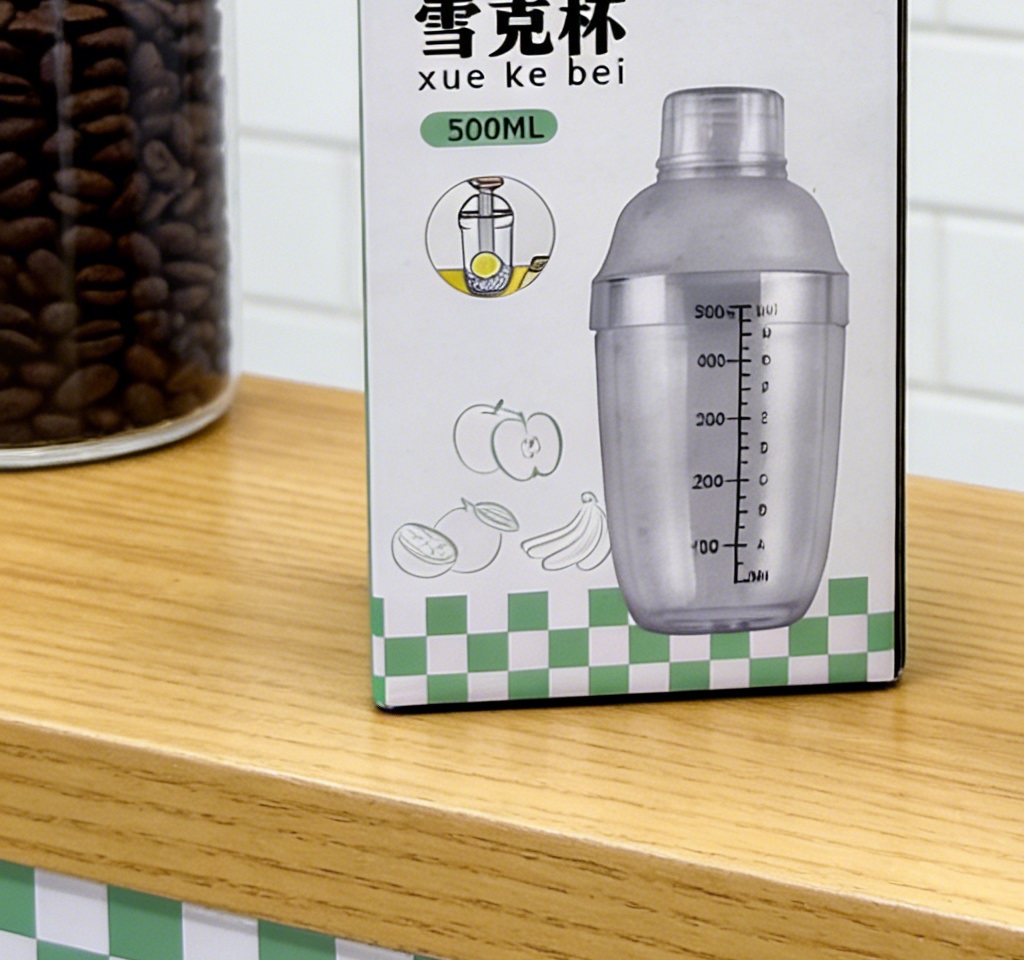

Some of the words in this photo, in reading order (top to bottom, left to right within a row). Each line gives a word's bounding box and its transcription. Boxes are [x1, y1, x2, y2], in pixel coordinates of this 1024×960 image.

[418, 69, 485, 91] xue
[506, 61, 547, 88] ke
[568, 55, 624, 86] bei
[448, 116, 545, 141] 500ML
[691, 473, 724, 490] 200
